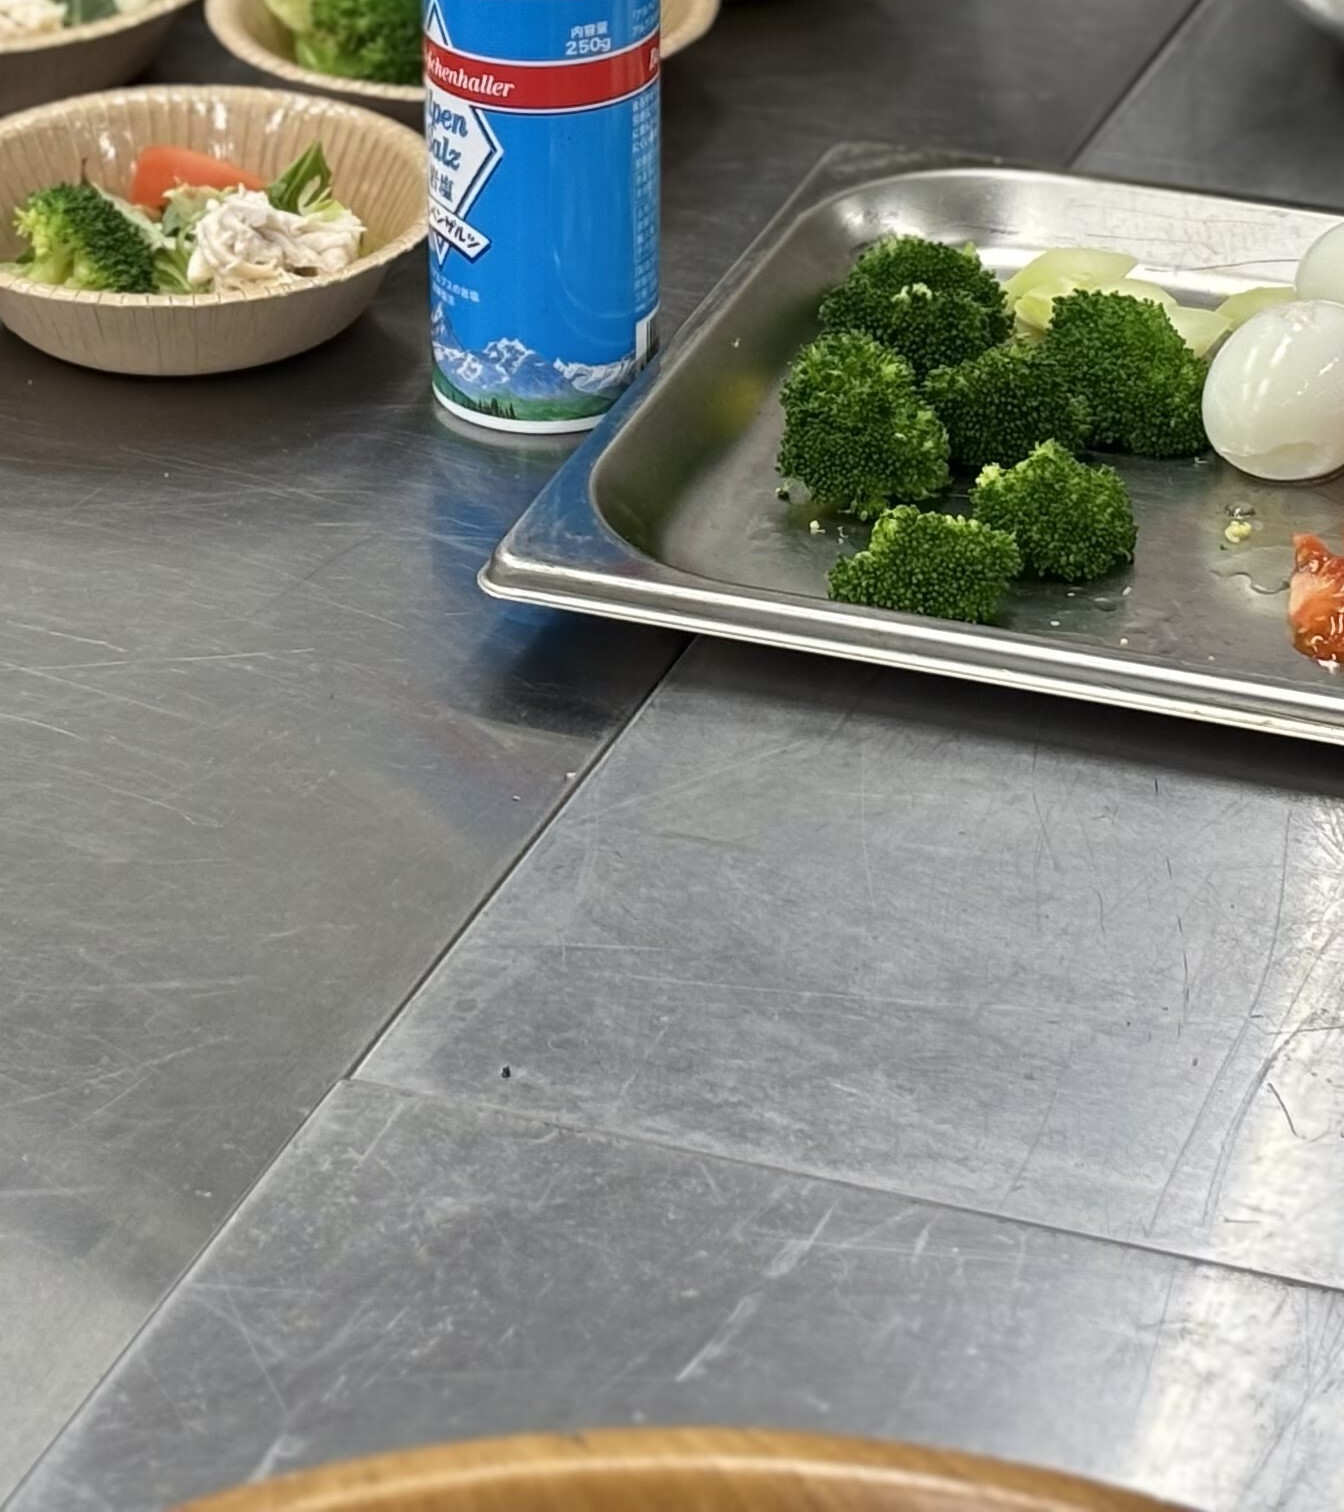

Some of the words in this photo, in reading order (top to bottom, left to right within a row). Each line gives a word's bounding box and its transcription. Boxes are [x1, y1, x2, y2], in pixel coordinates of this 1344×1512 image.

[570, 20, 609, 40] 内容量
[565, 37, 611, 56] 250g
[428, 88, 468, 138] lpen
